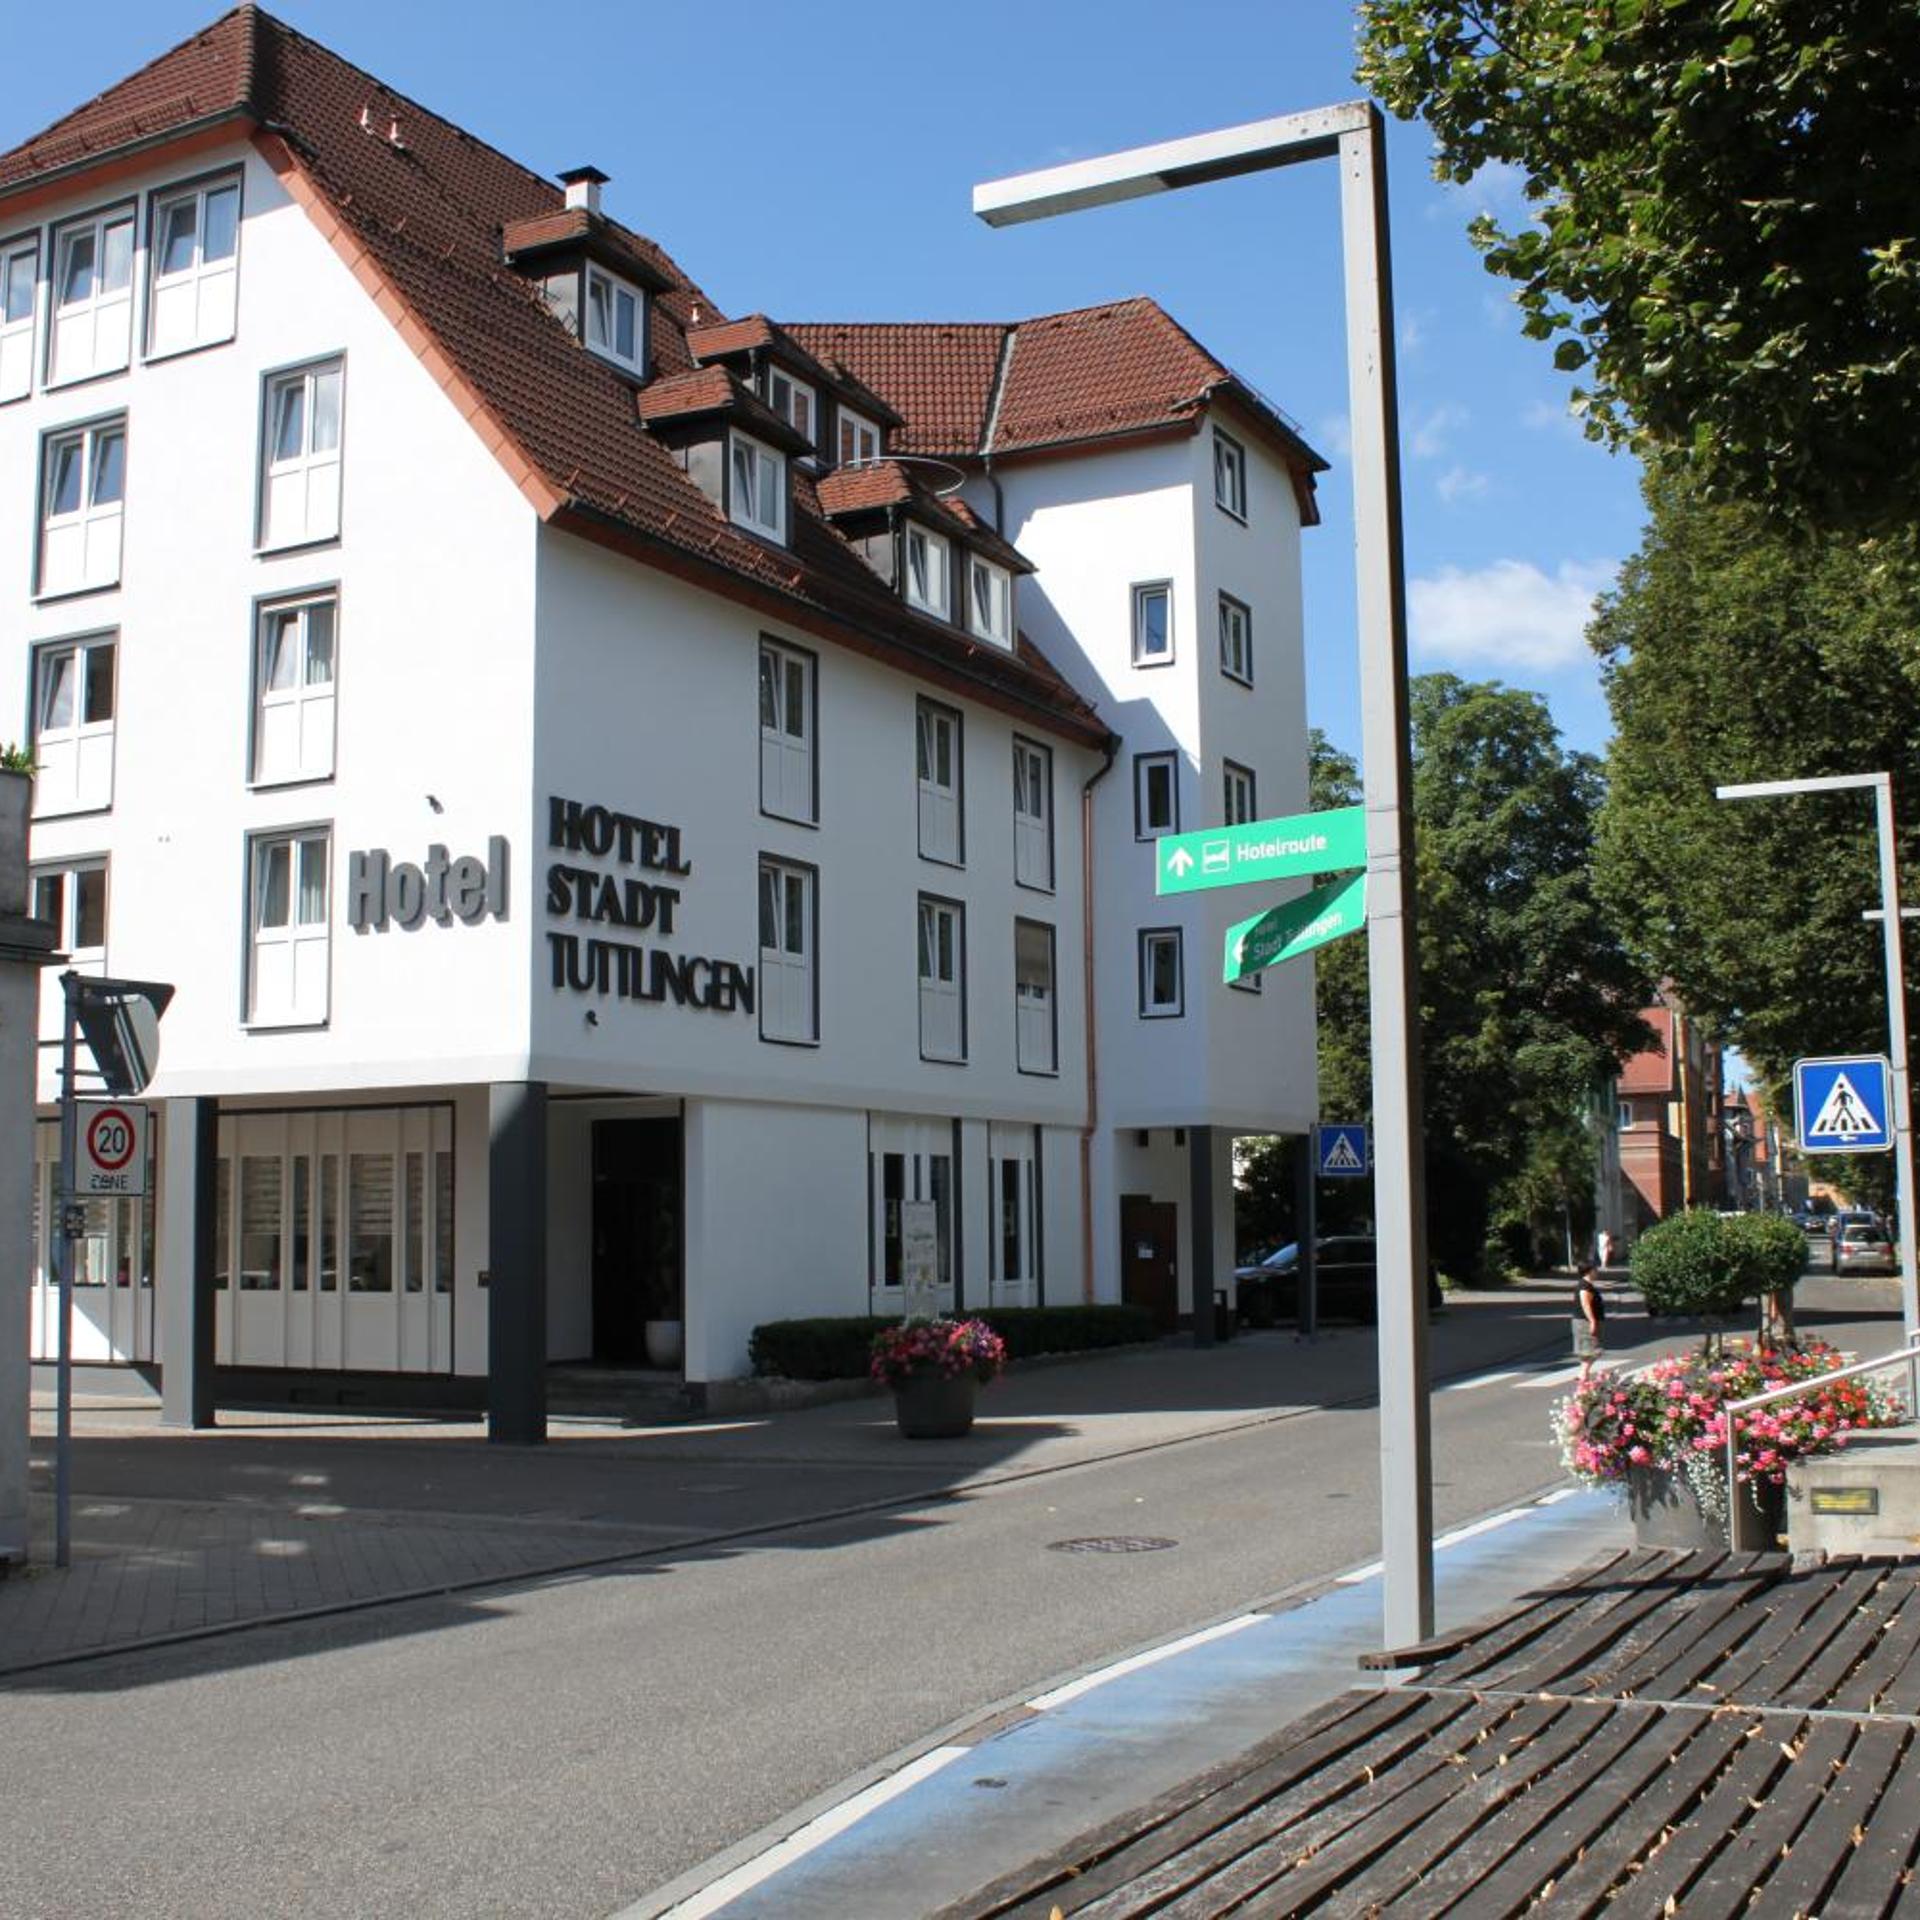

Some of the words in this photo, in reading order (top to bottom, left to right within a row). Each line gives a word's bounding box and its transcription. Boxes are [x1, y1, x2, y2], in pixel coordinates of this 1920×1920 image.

[549, 796, 691, 876] HOTEL
[1237, 834, 1327, 861] Hotelroute
[348, 835, 511, 935] Hotel
[546, 863, 681, 934] STADT
[546, 932, 755, 1014] TUTTLINGEN
[99, 1126, 126, 1153] 20
[91, 1174, 129, 1190] ZONE
